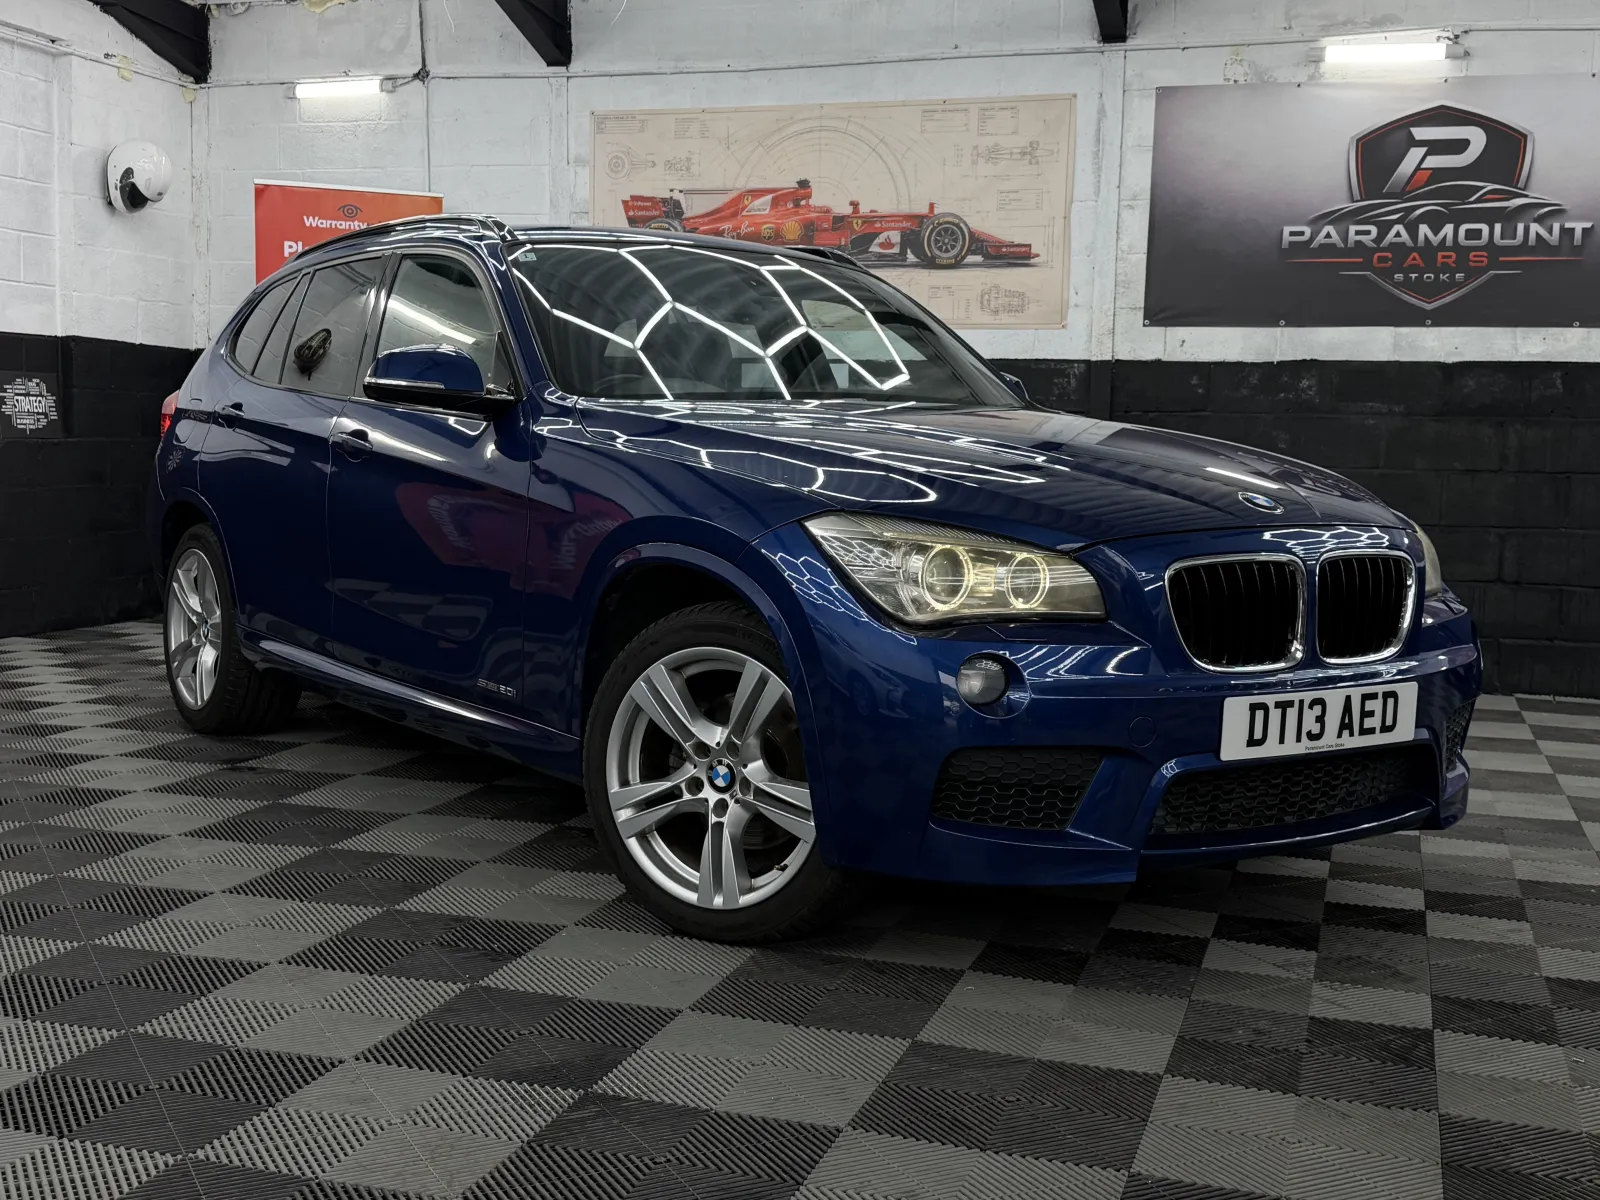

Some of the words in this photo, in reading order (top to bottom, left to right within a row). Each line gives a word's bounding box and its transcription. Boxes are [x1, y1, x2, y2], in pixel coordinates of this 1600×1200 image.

[303, 215, 368, 230] Warranty
[719, 221, 755, 240] Ray-Ban
[1281, 221, 1594, 250] PARAMOUNT
[1372, 251, 1489, 268] CARS
[1393, 272, 1466, 282] STOKE
[14, 395, 46, 412] STRATEGY
[1246, 697, 1327, 748] DT13
[1336, 690, 1399, 739] AED
